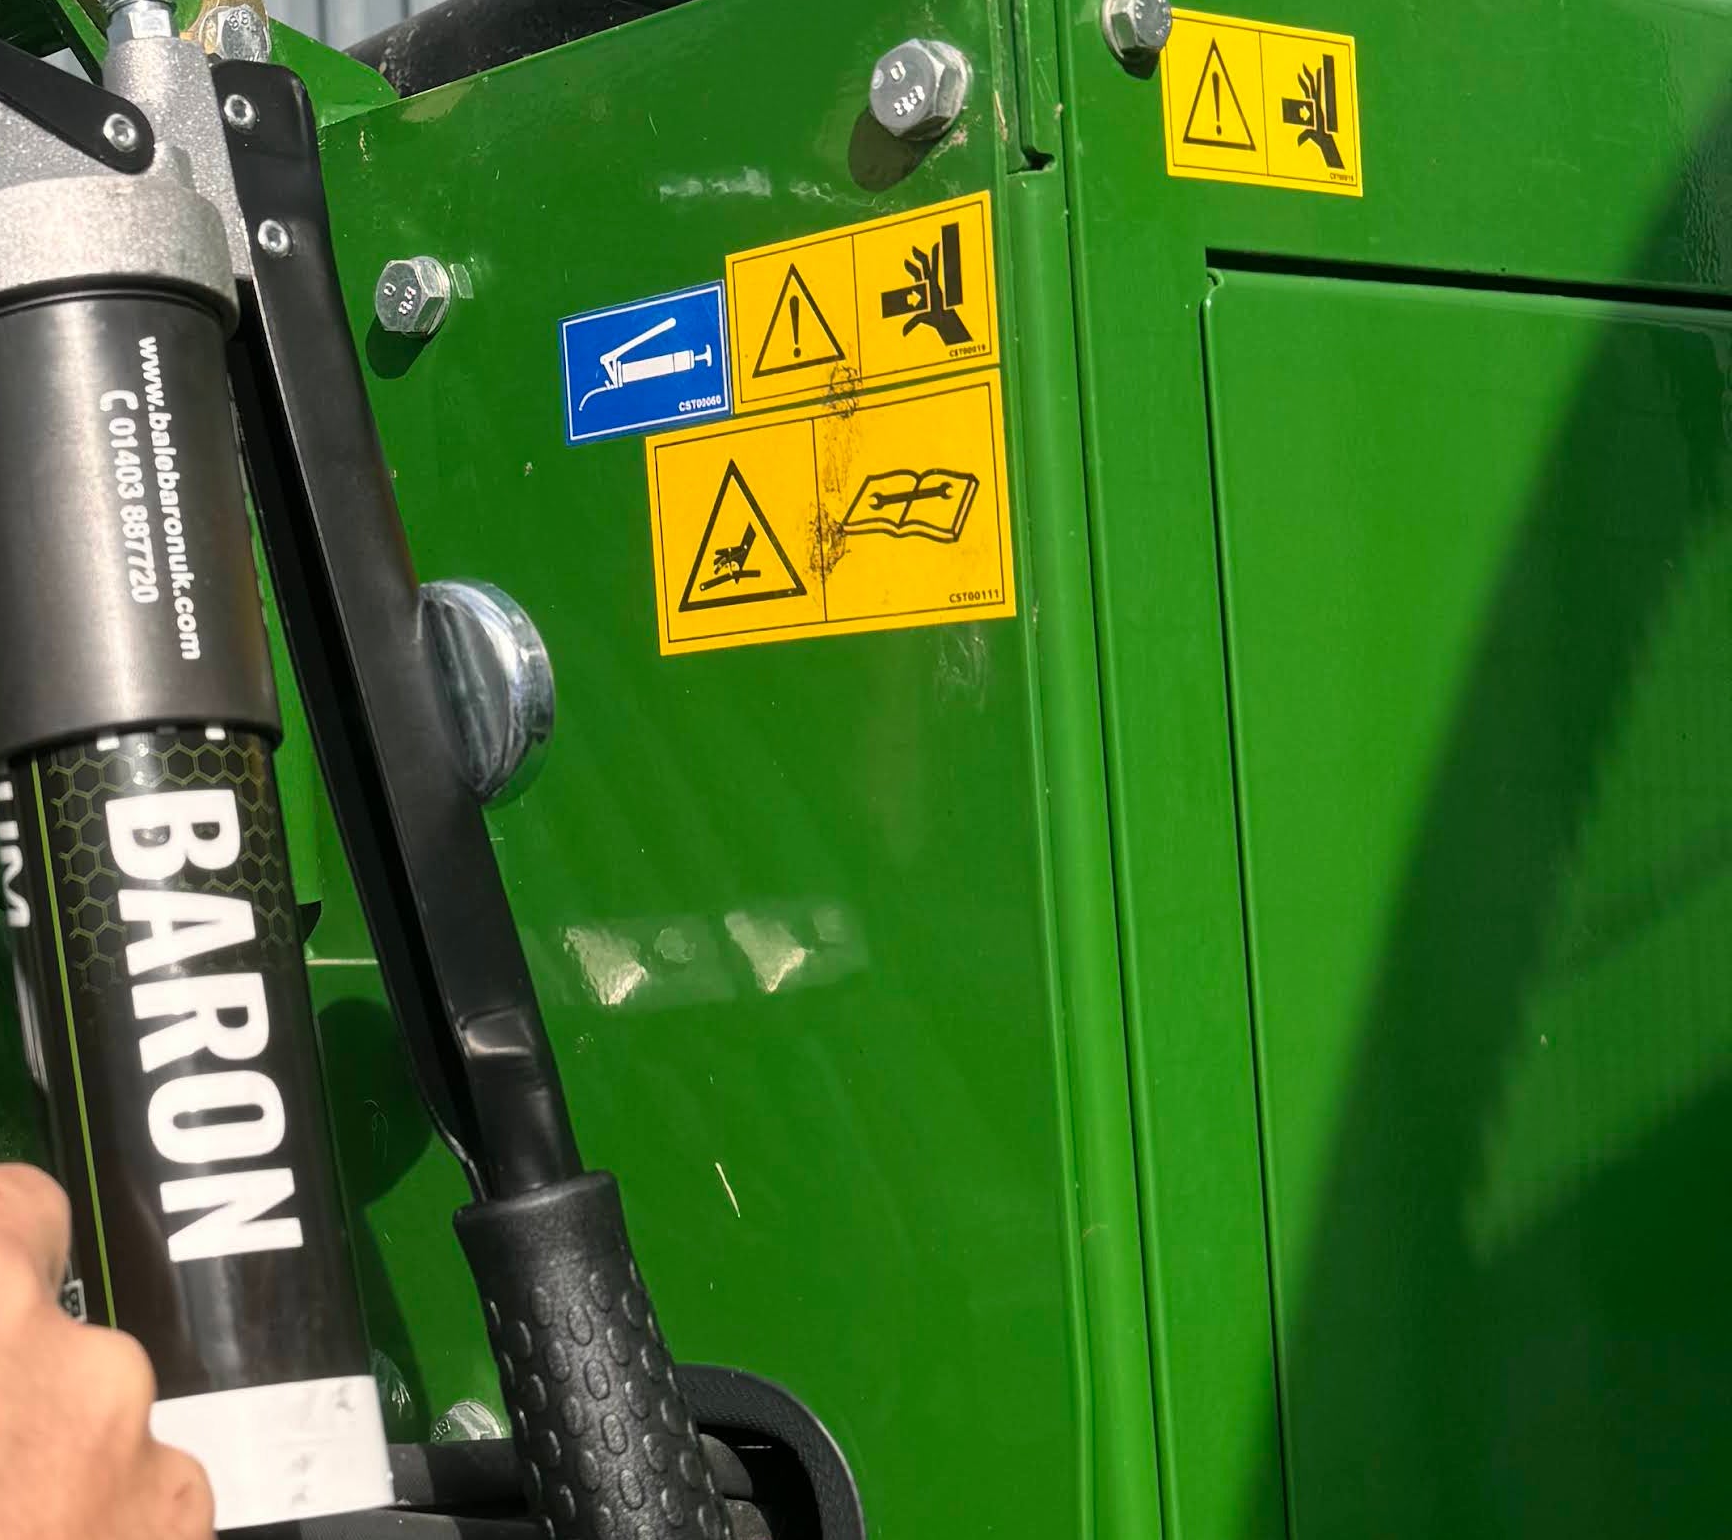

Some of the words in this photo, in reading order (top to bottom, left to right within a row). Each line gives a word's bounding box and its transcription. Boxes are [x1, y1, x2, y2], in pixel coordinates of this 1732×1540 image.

[109, 416, 145, 500] 01403
[137, 335, 201, 661] www.balebaronuk.com
[120, 504, 160, 604] 887720
[949, 589, 999, 604] CST00111
[105, 789, 304, 1263] BARON
